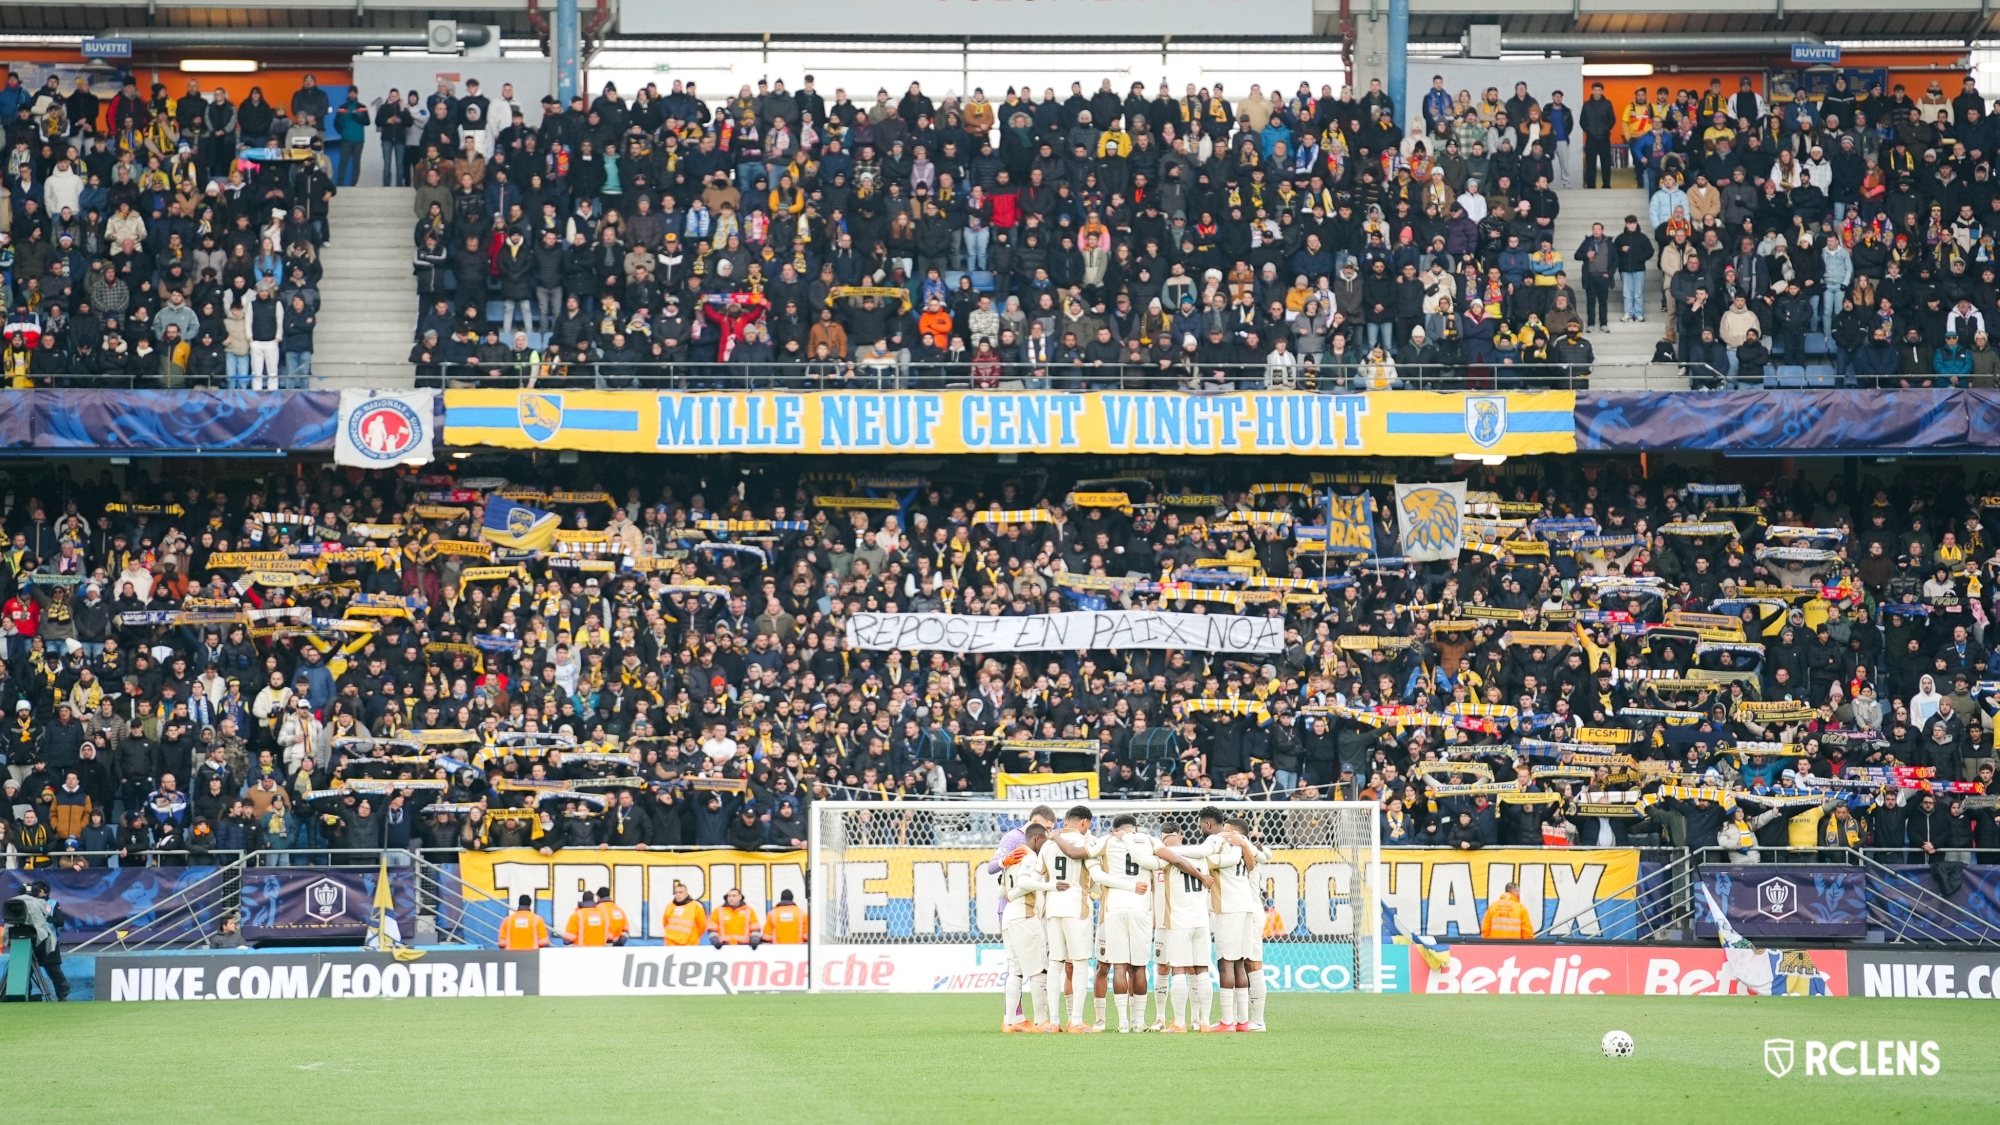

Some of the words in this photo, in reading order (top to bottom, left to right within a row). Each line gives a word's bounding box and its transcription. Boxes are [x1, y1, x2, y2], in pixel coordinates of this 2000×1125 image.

[85, 42, 128, 53] BUVETTE
[1795, 48, 1837, 58] BUVETTE
[363, 399, 407, 412] NATIONALE
[657, 394, 803, 447] MILLE
[820, 394, 942, 448] NEUF
[961, 394, 1083, 448] CENT
[1102, 394, 1368, 450] VINGT-HUIT
[368, 593, 408, 605] FCSM
[852, 614, 997, 651] REPOSE
[1016, 614, 1070, 647] EN
[1091, 613, 1188, 649] PAIX
[1206, 615, 1279, 651] NOA
[1588, 729, 1618, 738] FCSM
[1736, 740, 1782, 751] FCSM
[1006, 778, 1090, 801] INTERDITS
[1055, 855, 1067, 880] 9
[1125, 853, 1139, 876] 6
[110, 961, 524, 1001] NIKE.COM/FOOTBALL
[1426, 954, 1611, 995] Betclic
[1863, 963, 2000, 999] NIKE.C
